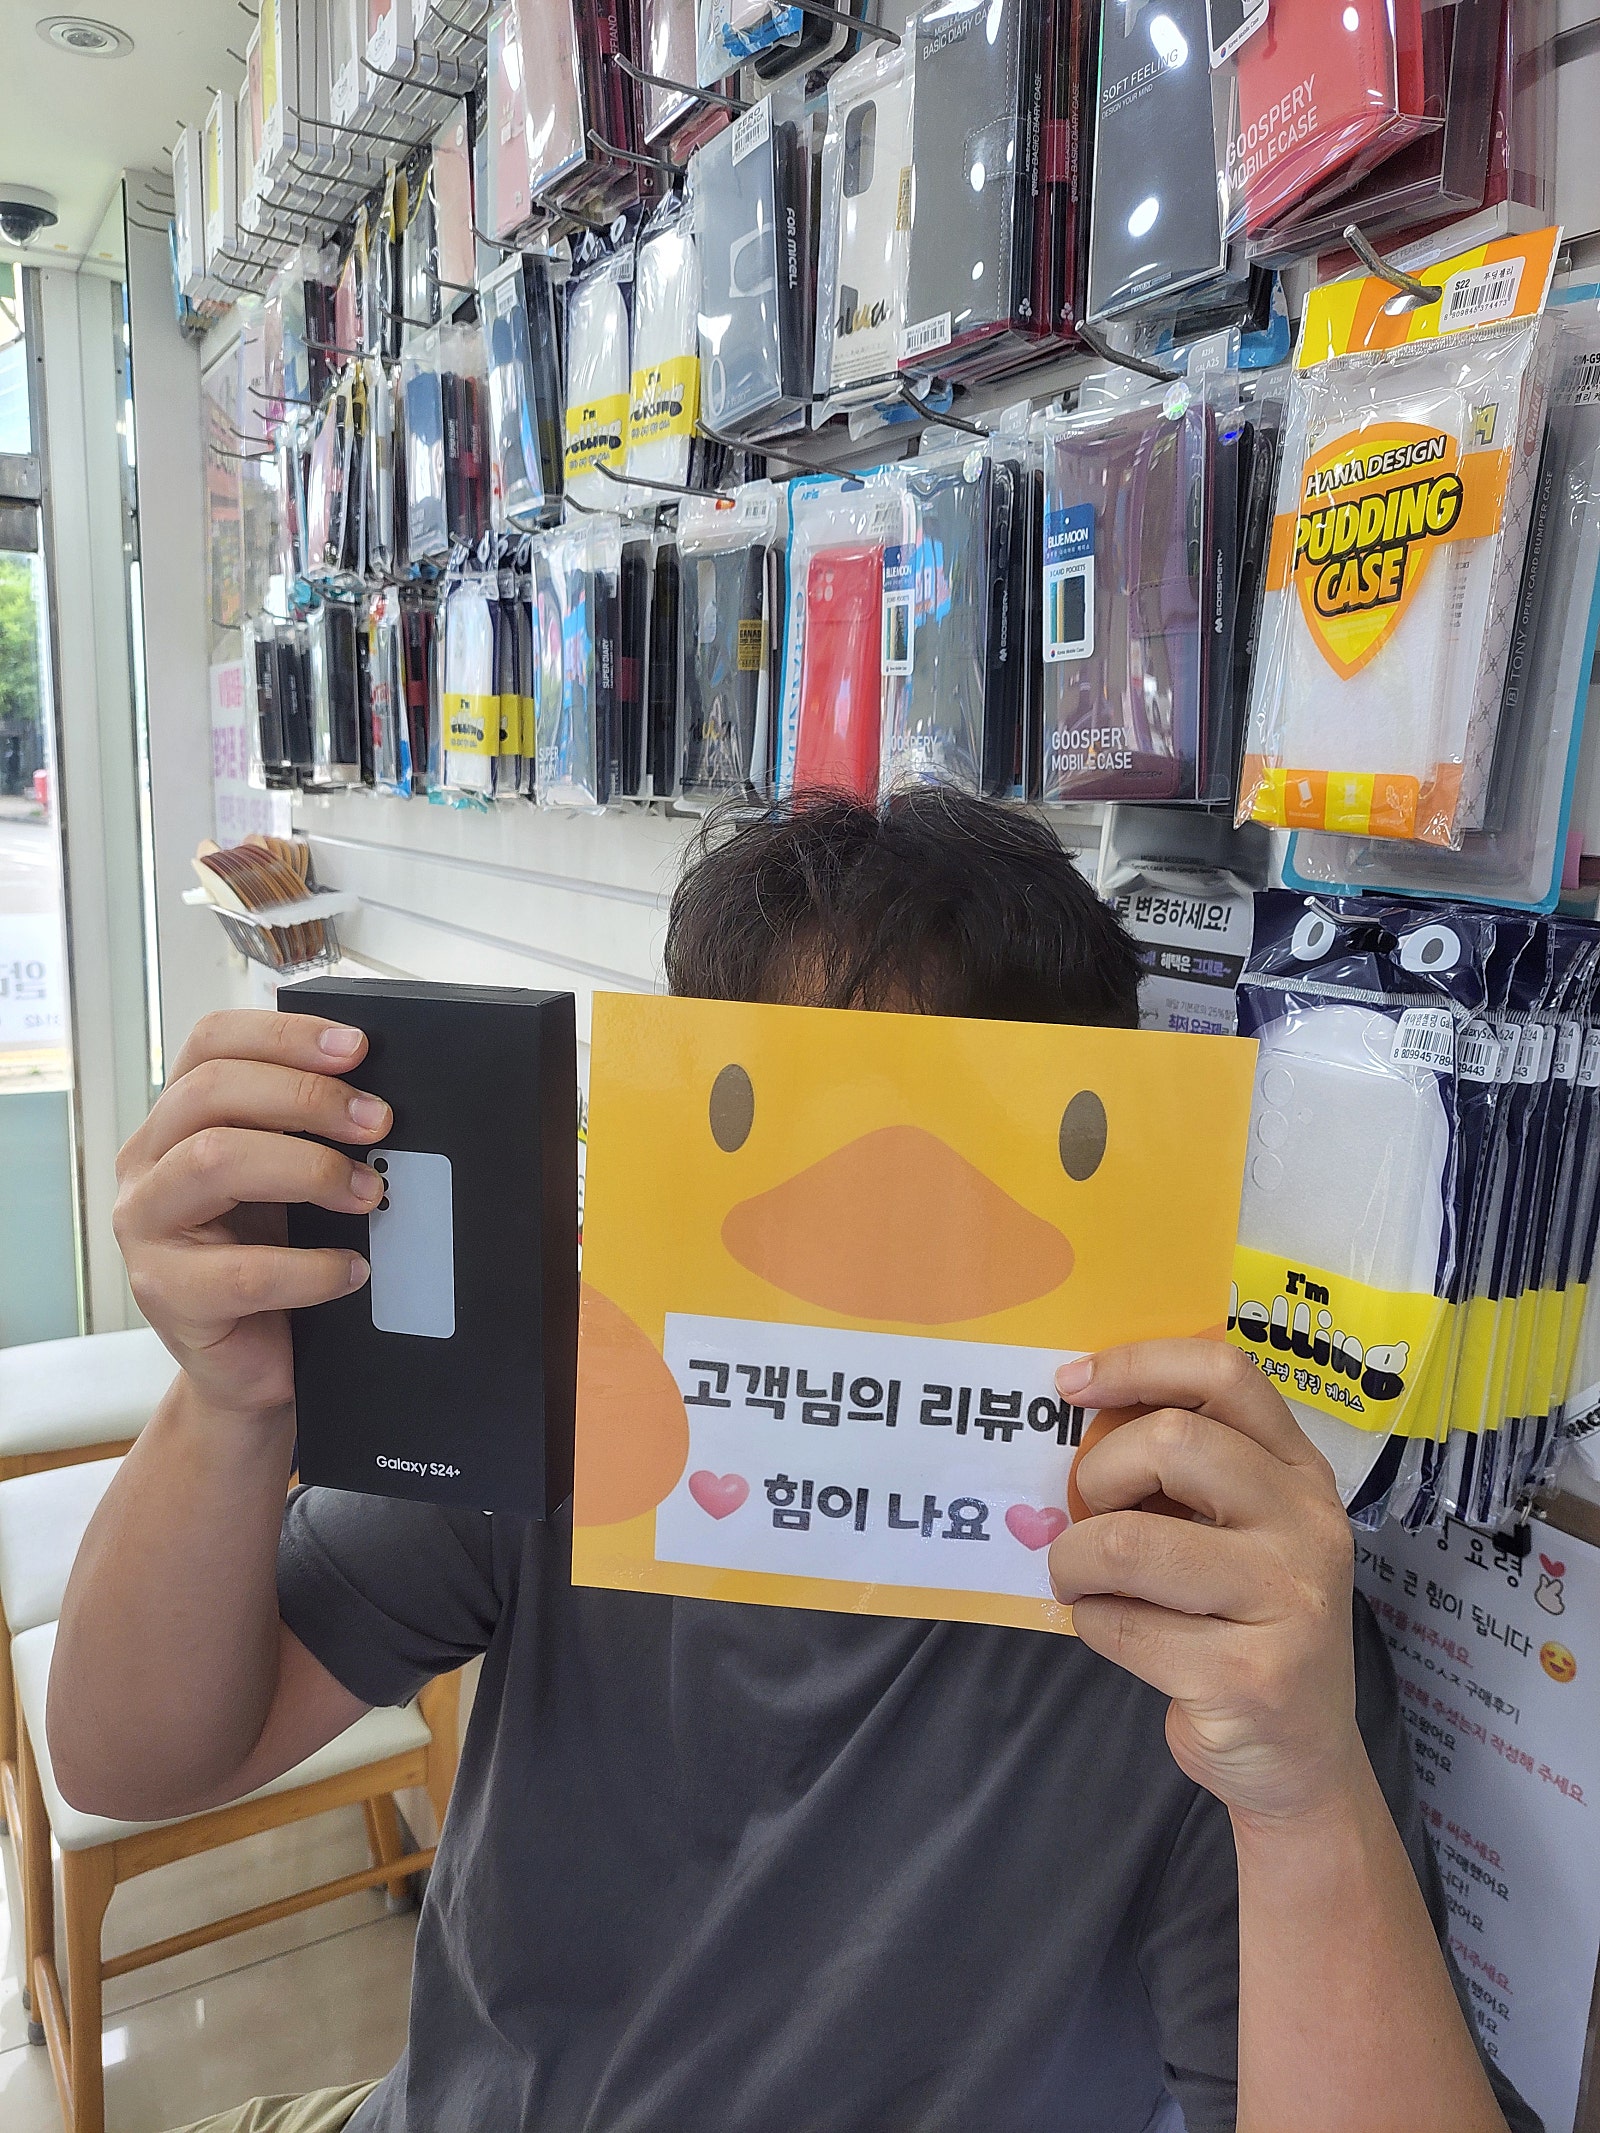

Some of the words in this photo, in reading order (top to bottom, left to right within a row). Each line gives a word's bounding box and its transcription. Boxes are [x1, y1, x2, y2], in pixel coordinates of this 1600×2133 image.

[923, 35, 947, 60] BASIC
[948, 18, 975, 44] DIARY
[1034, 73, 1042, 101] CASE
[1102, 77, 1129, 103] SOFT
[1130, 49, 1179, 86] FEELING
[737, 106, 761, 131] ZERO
[1033, 102, 1041, 133] DIARY
[1102, 101, 1122, 119] DESIGN
[1122, 92, 1138, 110] YOUR
[1138, 83, 1154, 100] MIND
[1227, 73, 1316, 167] GOOSPERY
[786, 207, 796, 237] FOR
[787, 238, 798, 290] MICELL
[1455, 279, 1470, 291] S22
[1306, 460, 1363, 498] HANA
[1366, 434, 1447, 478] DESIGN
[1292, 473, 1463, 572] PUDDING
[1315, 543, 1407, 617] CASE
[1510, 628, 1528, 681] TONY
[1521, 590, 1531, 625] OPEN
[1526, 556, 1538, 589] CARD
[1532, 503, 1548, 555] BUMPER
[1542, 470, 1553, 501] CASE
[602, 637, 610, 662] DIARY
[539, 747, 559, 763] SUPER
[1052, 727, 1132, 750] GOOSPERY
[1136, 896, 1231, 932] 변경하세요!
[1161, 951, 1191, 973] 혜택은
[1168, 1012, 1190, 1032] 최저
[1401, 1049, 1432, 1062] 809945
[1286, 1271, 1330, 1306] I'm
[683, 1358, 901, 1428] 고객님의
[919, 1384, 1084, 1447] 리뷰에
[1262, 1357, 1290, 1383] 투명
[1294, 1368, 1321, 1394] 젤링
[1325, 1382, 1366, 1413] 케이스
[376, 1455, 428, 1477] Galaxy
[429, 1462, 461, 1478] S24+
[763, 1473, 870, 1532] 힘이
[887, 1493, 992, 1542] 나요
[1354, 1545, 1396, 1584] 기는
[1402, 1569, 1419, 1598] 큰
[1425, 1579, 1464, 1621] 힘이
[1471, 1602, 1534, 1658] 됩니다
[1464, 1678, 1521, 1726] 구매후기
[1489, 1732, 1535, 1775] 작성해
